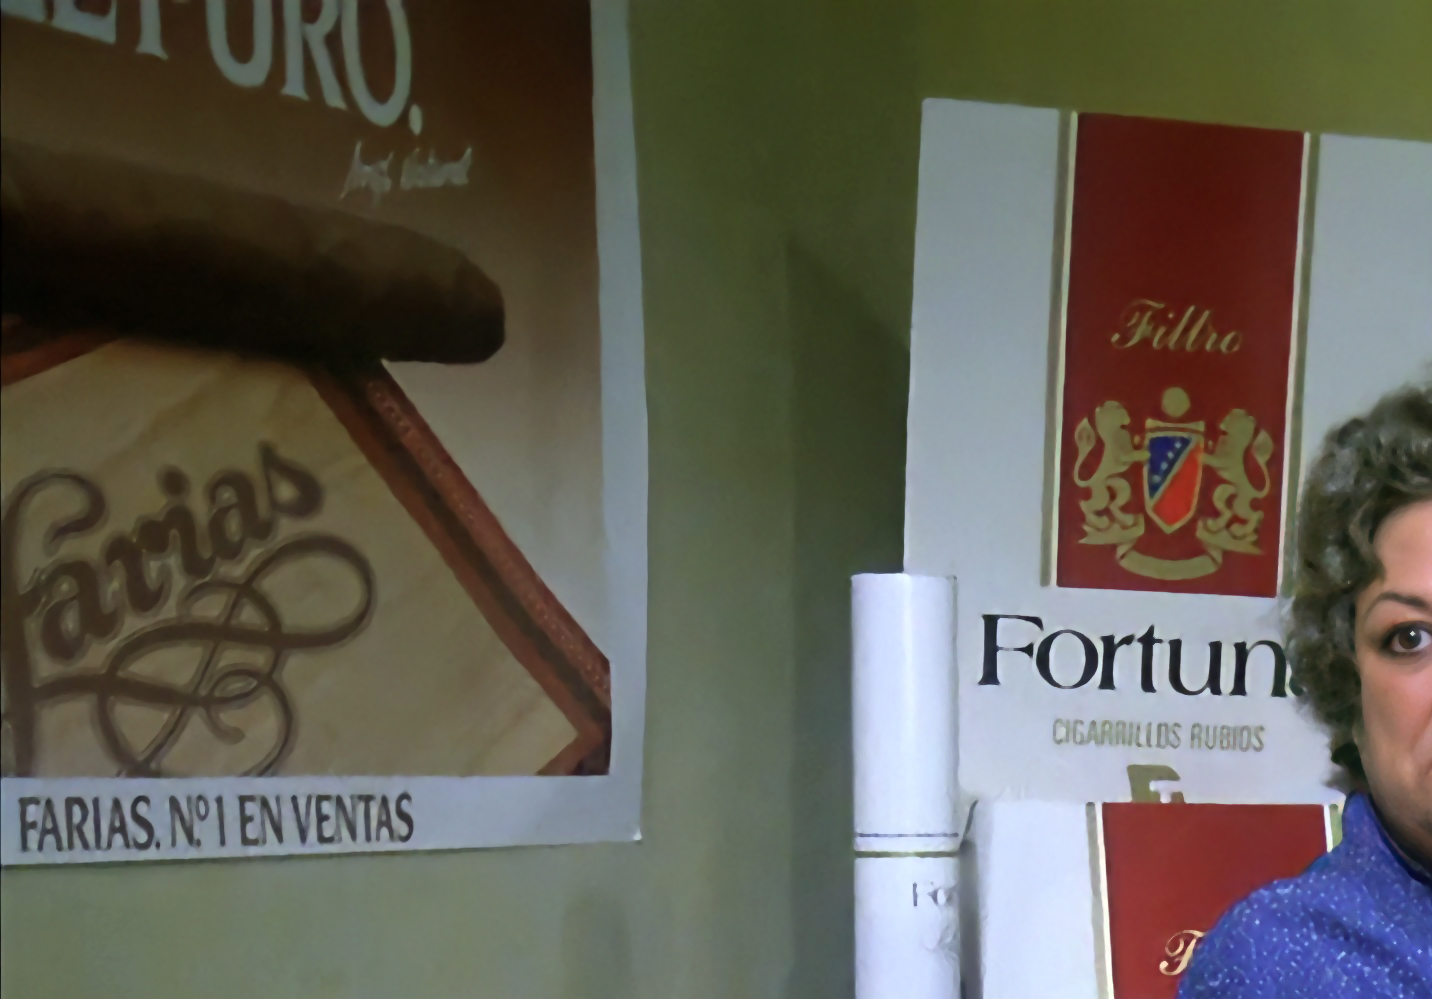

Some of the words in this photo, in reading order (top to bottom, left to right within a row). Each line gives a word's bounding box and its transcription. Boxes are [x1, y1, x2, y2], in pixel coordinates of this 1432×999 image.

[1110, 298, 1243, 355] Filtro
[1052, 717, 1182, 751] CIGARRILLOS
[1189, 722, 1267, 753] RUBIOS
[17, 795, 161, 853] FARIAS.
[239, 793, 285, 847] EN
[290, 790, 415, 846] VENTAS
